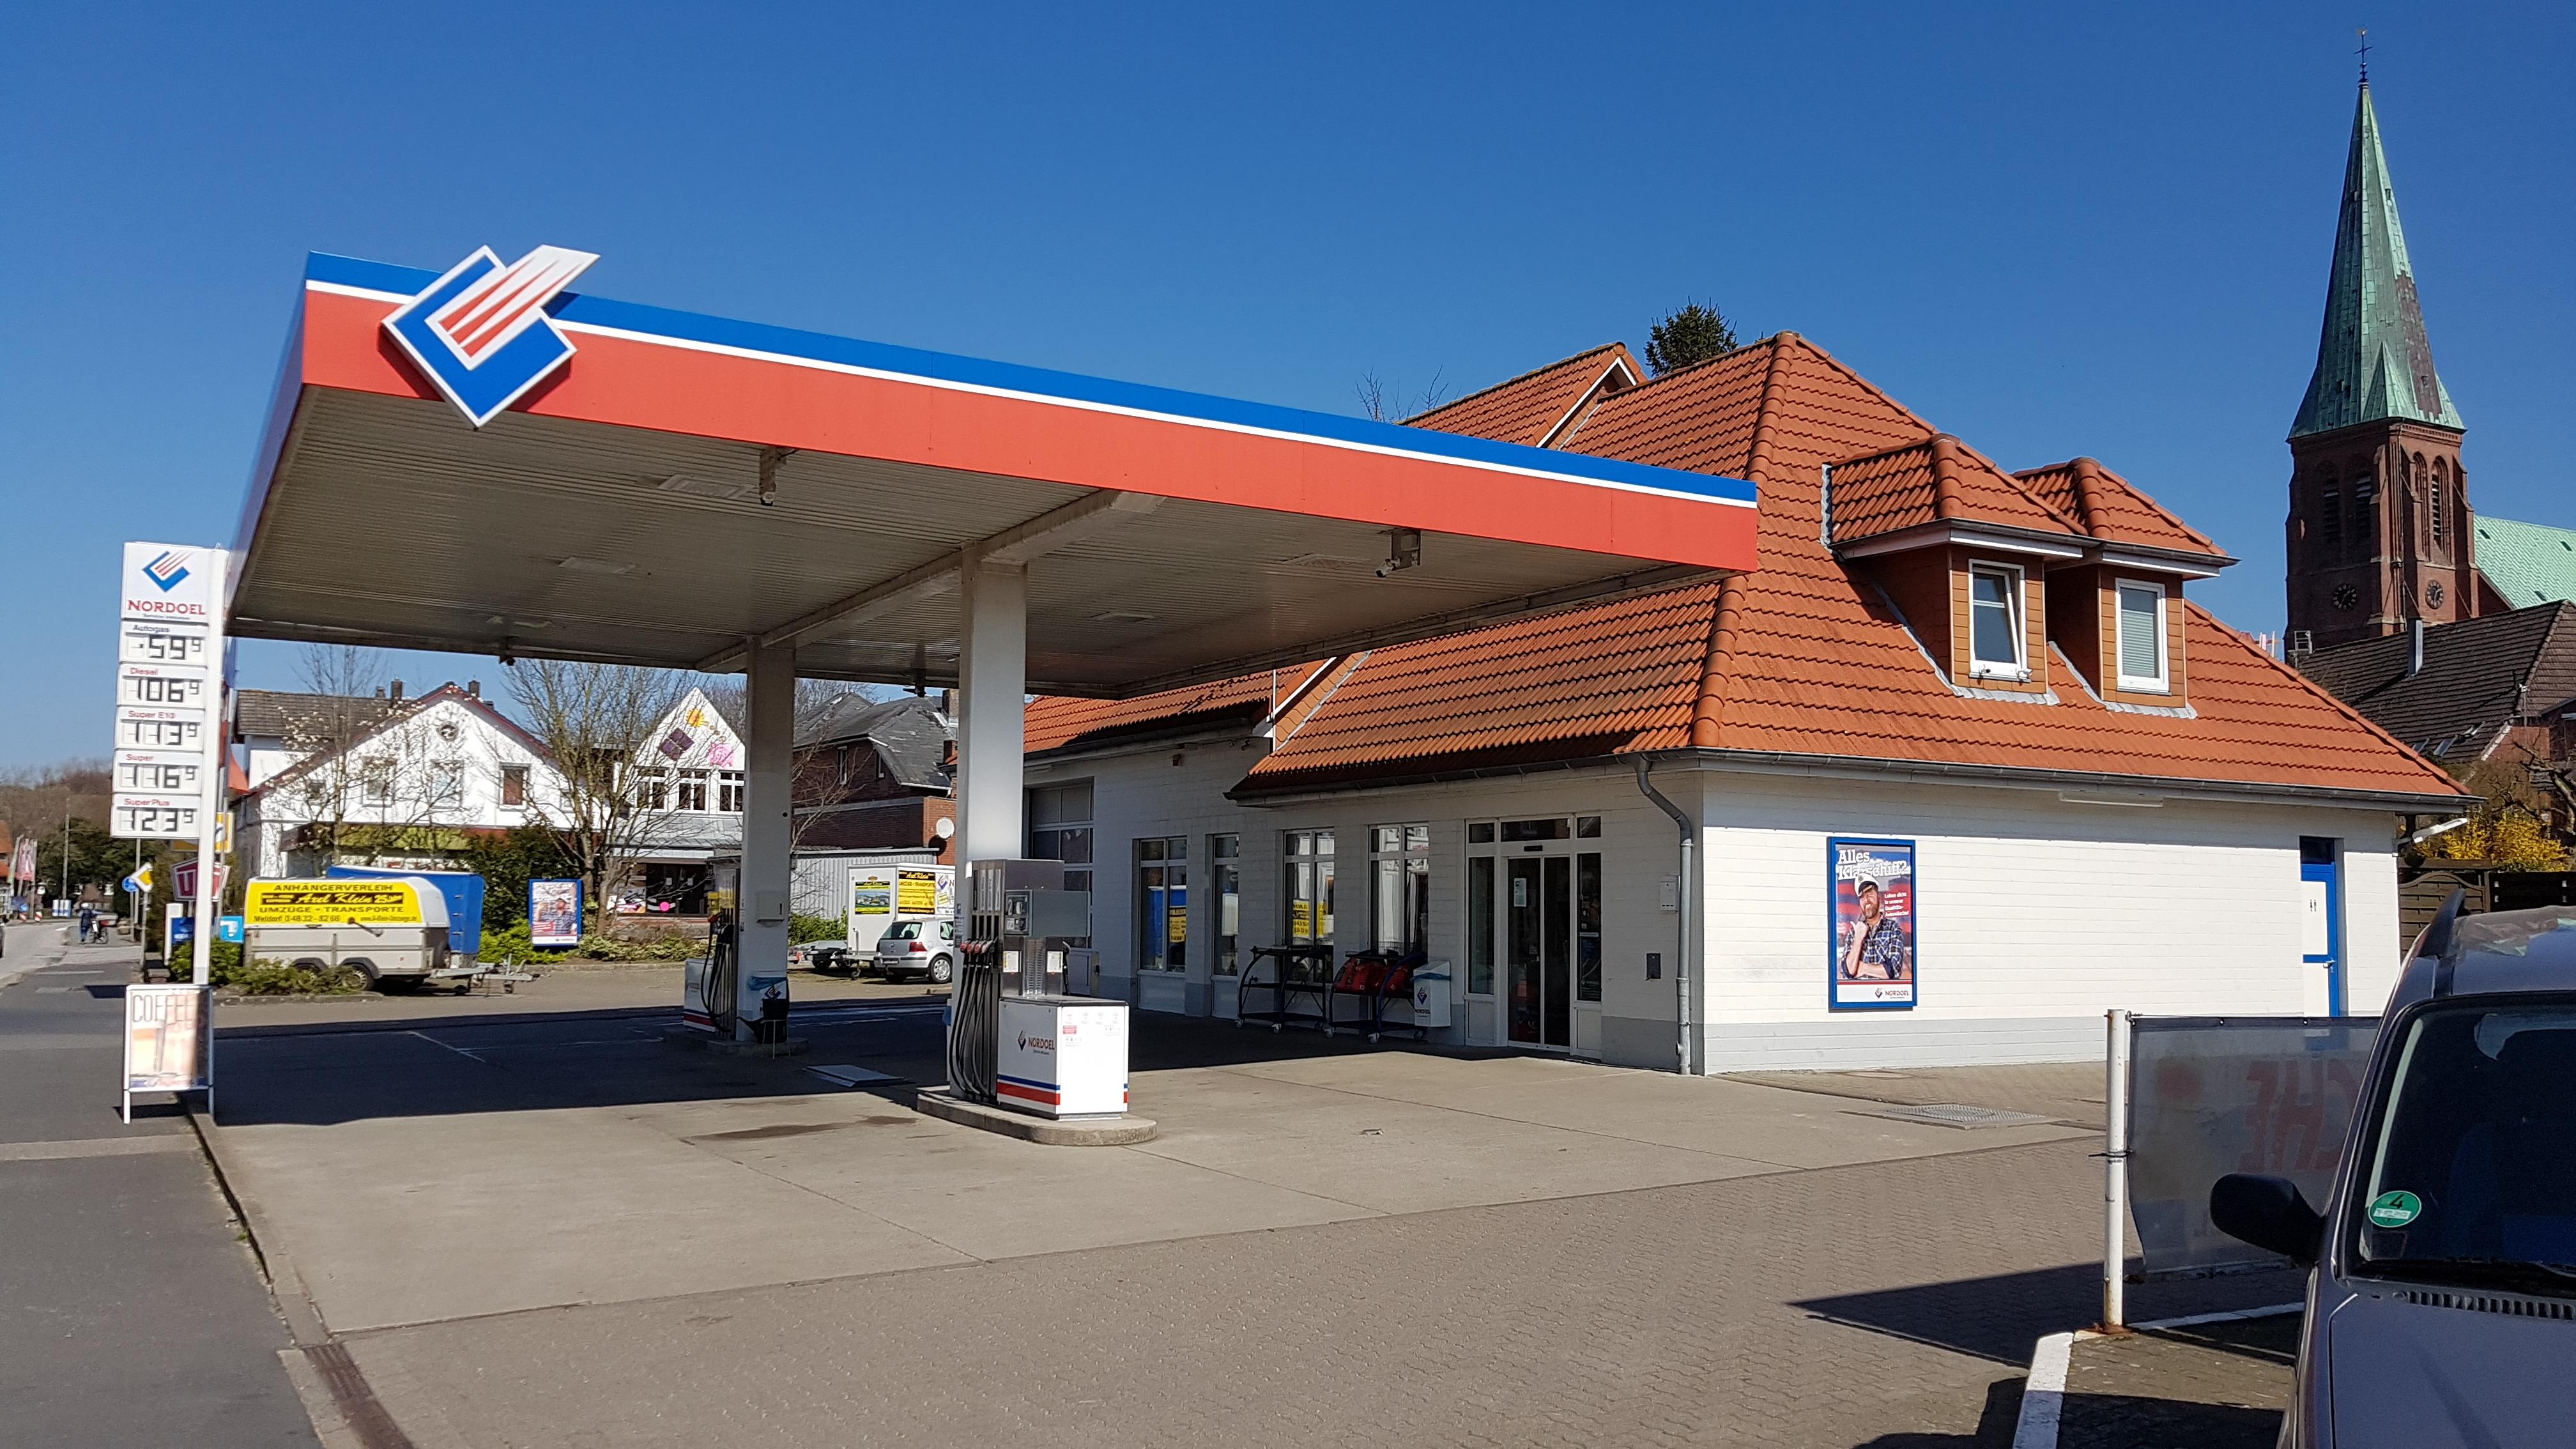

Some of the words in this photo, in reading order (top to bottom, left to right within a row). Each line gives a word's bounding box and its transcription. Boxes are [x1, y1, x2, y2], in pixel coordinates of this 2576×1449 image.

[127, 600, 206, 615] NORDOEL
[133, 624, 169, 633] Autogas
[1837, 849, 1870, 864] Alles
[1837, 861, 1906, 880] Klarschiff?
[273, 884, 394, 892] ANHÄNGERVERLEIH
[295, 894, 332, 903] Axel
[334, 894, 372, 903] Klein
[132, 994, 195, 1023] COFFEE
[1028, 1036, 1055, 1050] NORDOEL
[2389, 1193, 2405, 1209] 4
